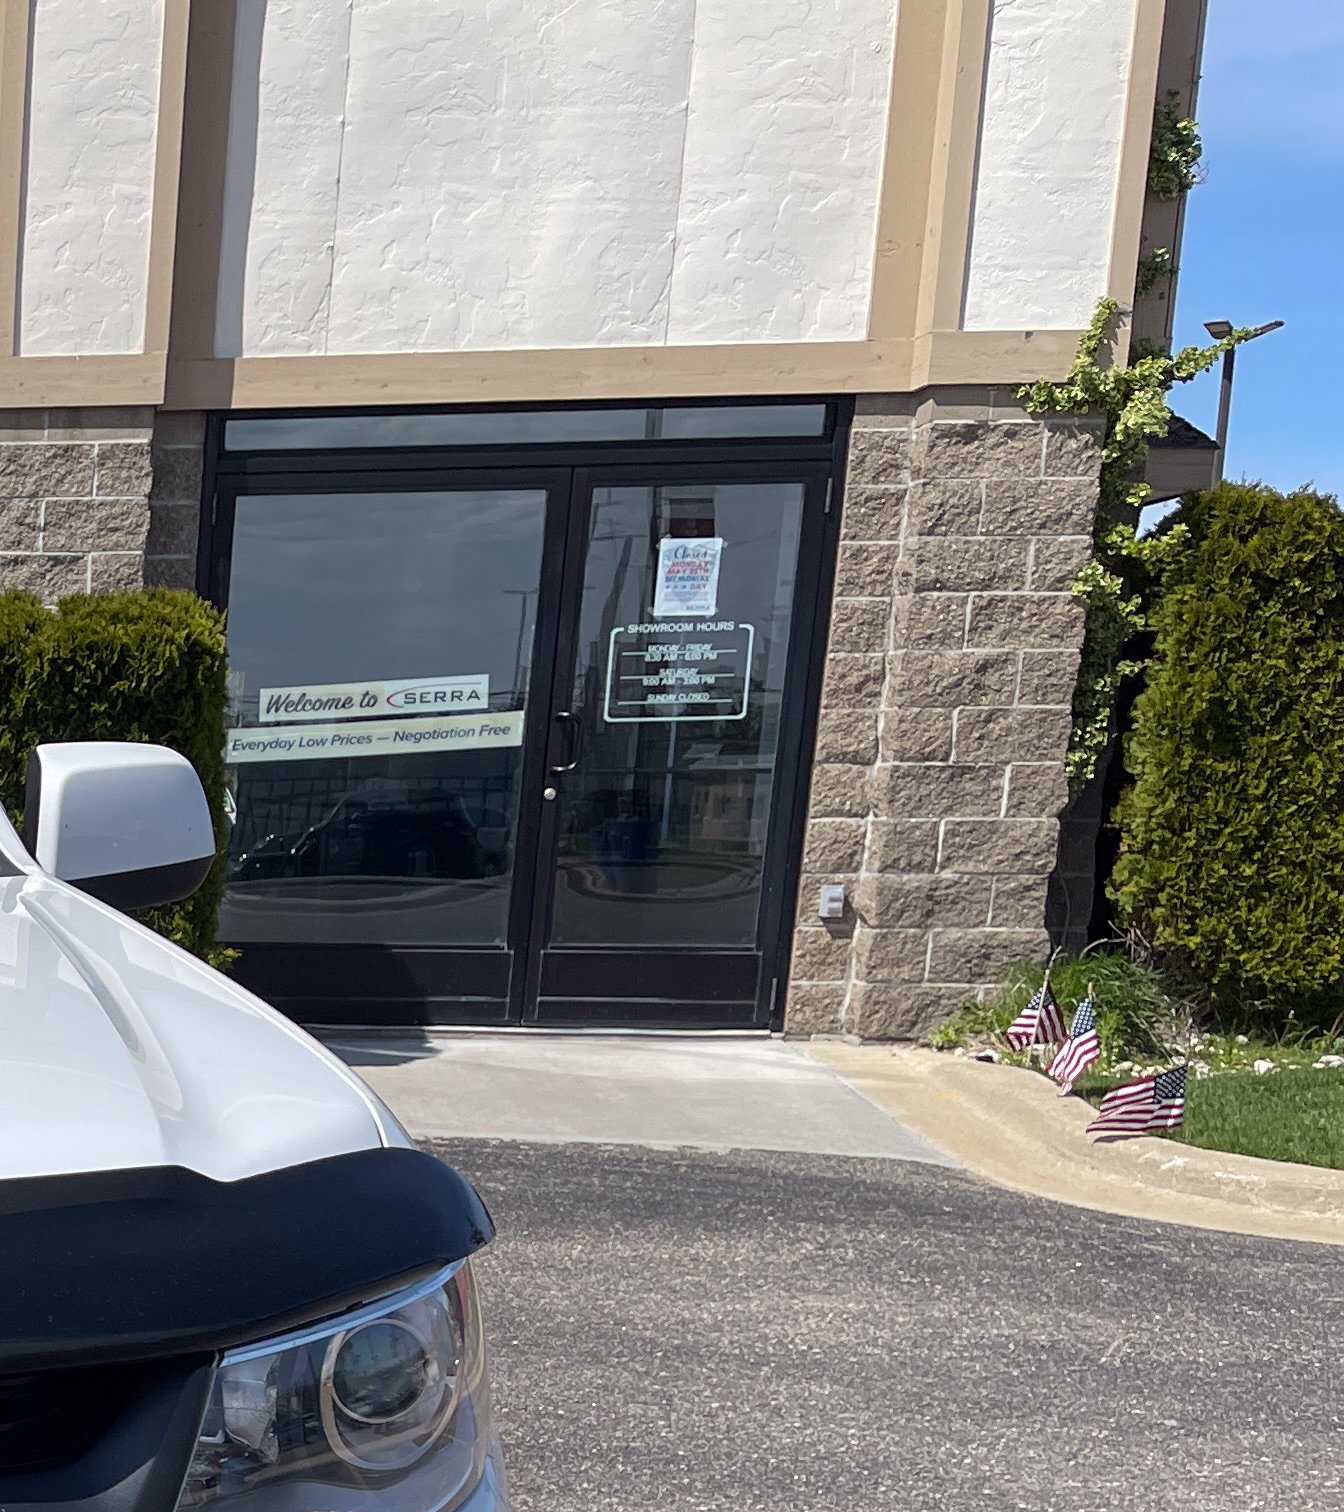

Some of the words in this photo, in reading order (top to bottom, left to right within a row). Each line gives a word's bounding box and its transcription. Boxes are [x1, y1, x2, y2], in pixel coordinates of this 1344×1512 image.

[627, 622, 694, 634] SHOWROOM
[696, 621, 735, 632] HOURS
[266, 691, 355, 715] Welcome
[359, 689, 378, 709] to
[403, 688, 482, 705] SERRA
[232, 737, 296, 753] Everyday
[298, 734, 328, 748] Low
[330, 732, 374, 746] Prices
[392, 726, 476, 744] Negotiation
[478, 723, 512, 737] Free
